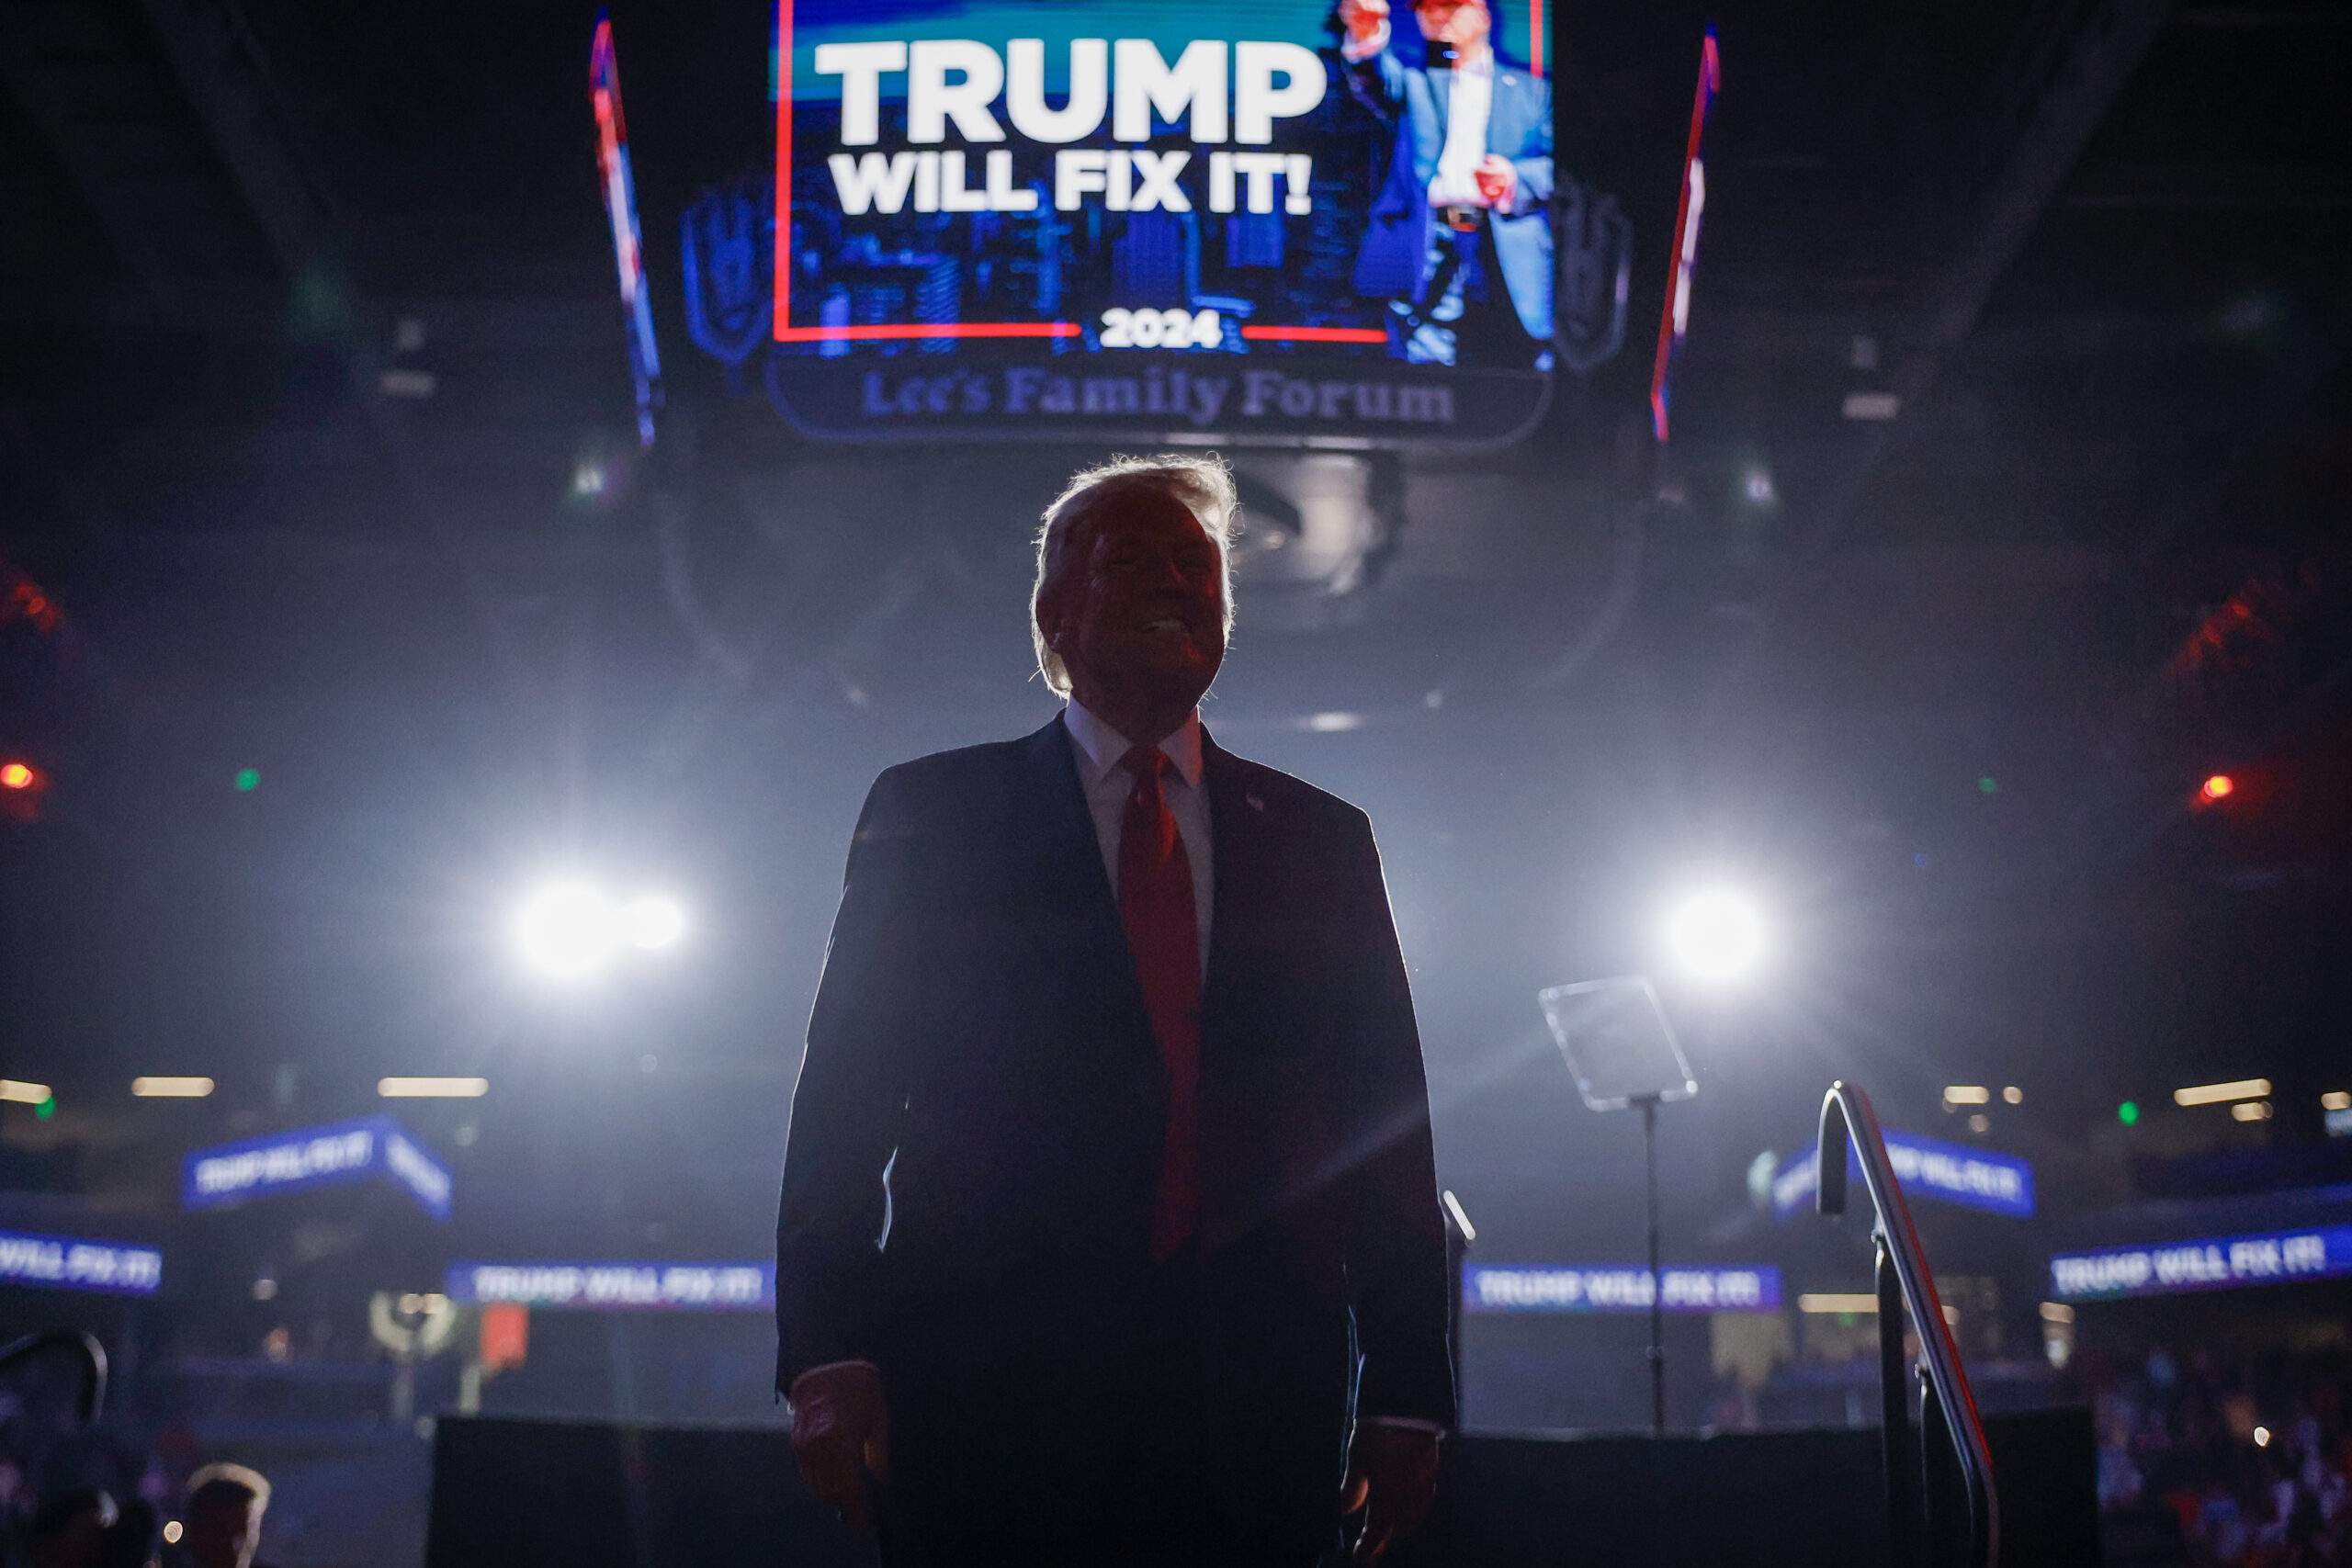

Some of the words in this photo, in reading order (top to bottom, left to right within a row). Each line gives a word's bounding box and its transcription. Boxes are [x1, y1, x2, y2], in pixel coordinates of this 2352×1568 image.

[814, 39, 1328, 145] TRUMP
[829, 152, 1039, 215] WILL
[1055, 150, 1192, 213] FIX
[1209, 152, 1313, 216] IT!
[1100, 308, 1222, 349] 2024
[862, 369, 991, 415] Lee's
[1005, 368, 1233, 424] Family
[1238, 371, 1455, 423] Forum
[1475, 1269, 1584, 1307] TRUMP
[1583, 1270, 1657, 1308] WILL
[1661, 1270, 1716, 1306] FIX
[2052, 1251, 2152, 1294] TRUMP
[2152, 1244, 2229, 1284] WILL
[2229, 1239, 2282, 1278] FIX
